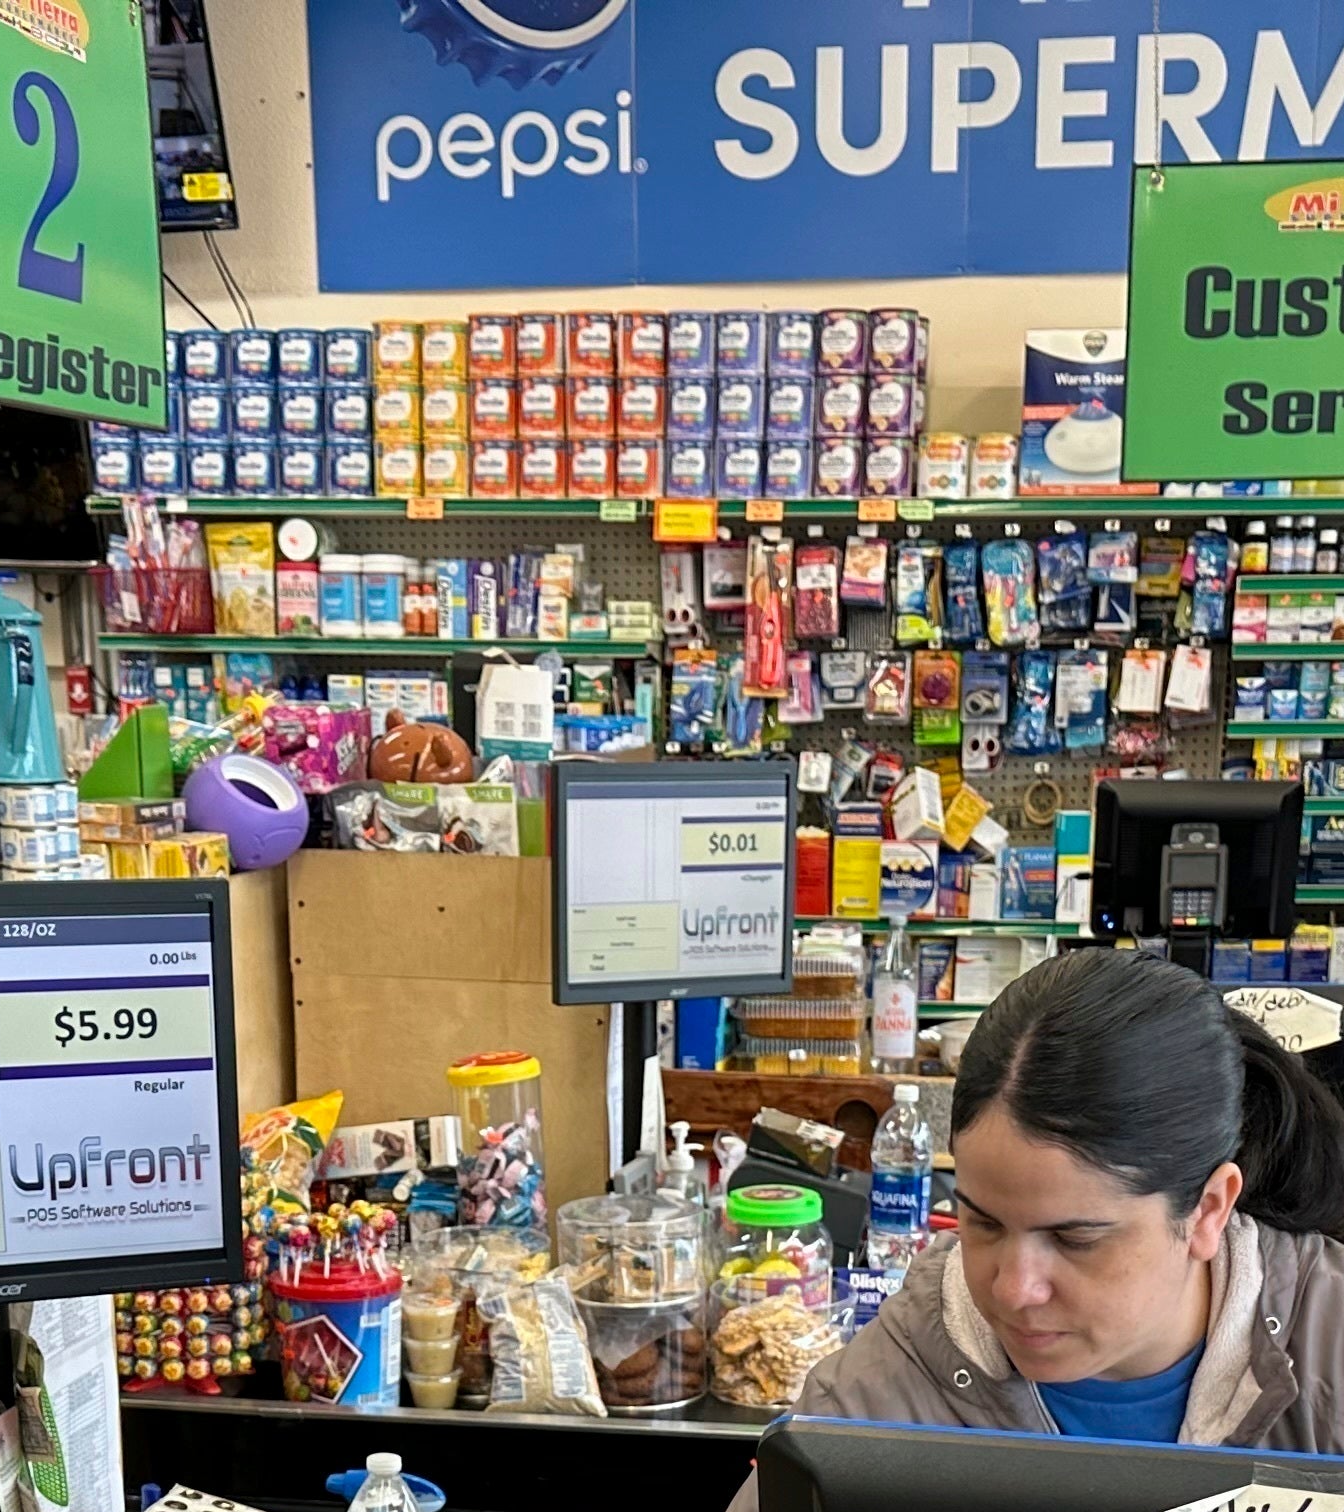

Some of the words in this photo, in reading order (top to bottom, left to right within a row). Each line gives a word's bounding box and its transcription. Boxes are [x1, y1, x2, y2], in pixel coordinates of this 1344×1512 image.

[375, 90, 634, 202] pepsi
[12, 71, 85, 303] 2
[1290, 191, 1340, 213] Mi
[1055, 372, 1091, 385] Warm
[709, 831, 759, 855] $0.01
[3, 923, 57, 938] 128/OZ
[683, 904, 779, 941] Upfront
[149, 953, 179, 965] 0.00
[181, 952, 197, 961] Lbs
[55, 1006, 157, 1048] $5.99
[134, 1078, 185, 1094] Regular
[8, 1133, 211, 1201] Upfront
[27, 1208, 58, 1222] POS
[62, 1204, 126, 1220] Software
[130, 1198, 192, 1215] Solutions
